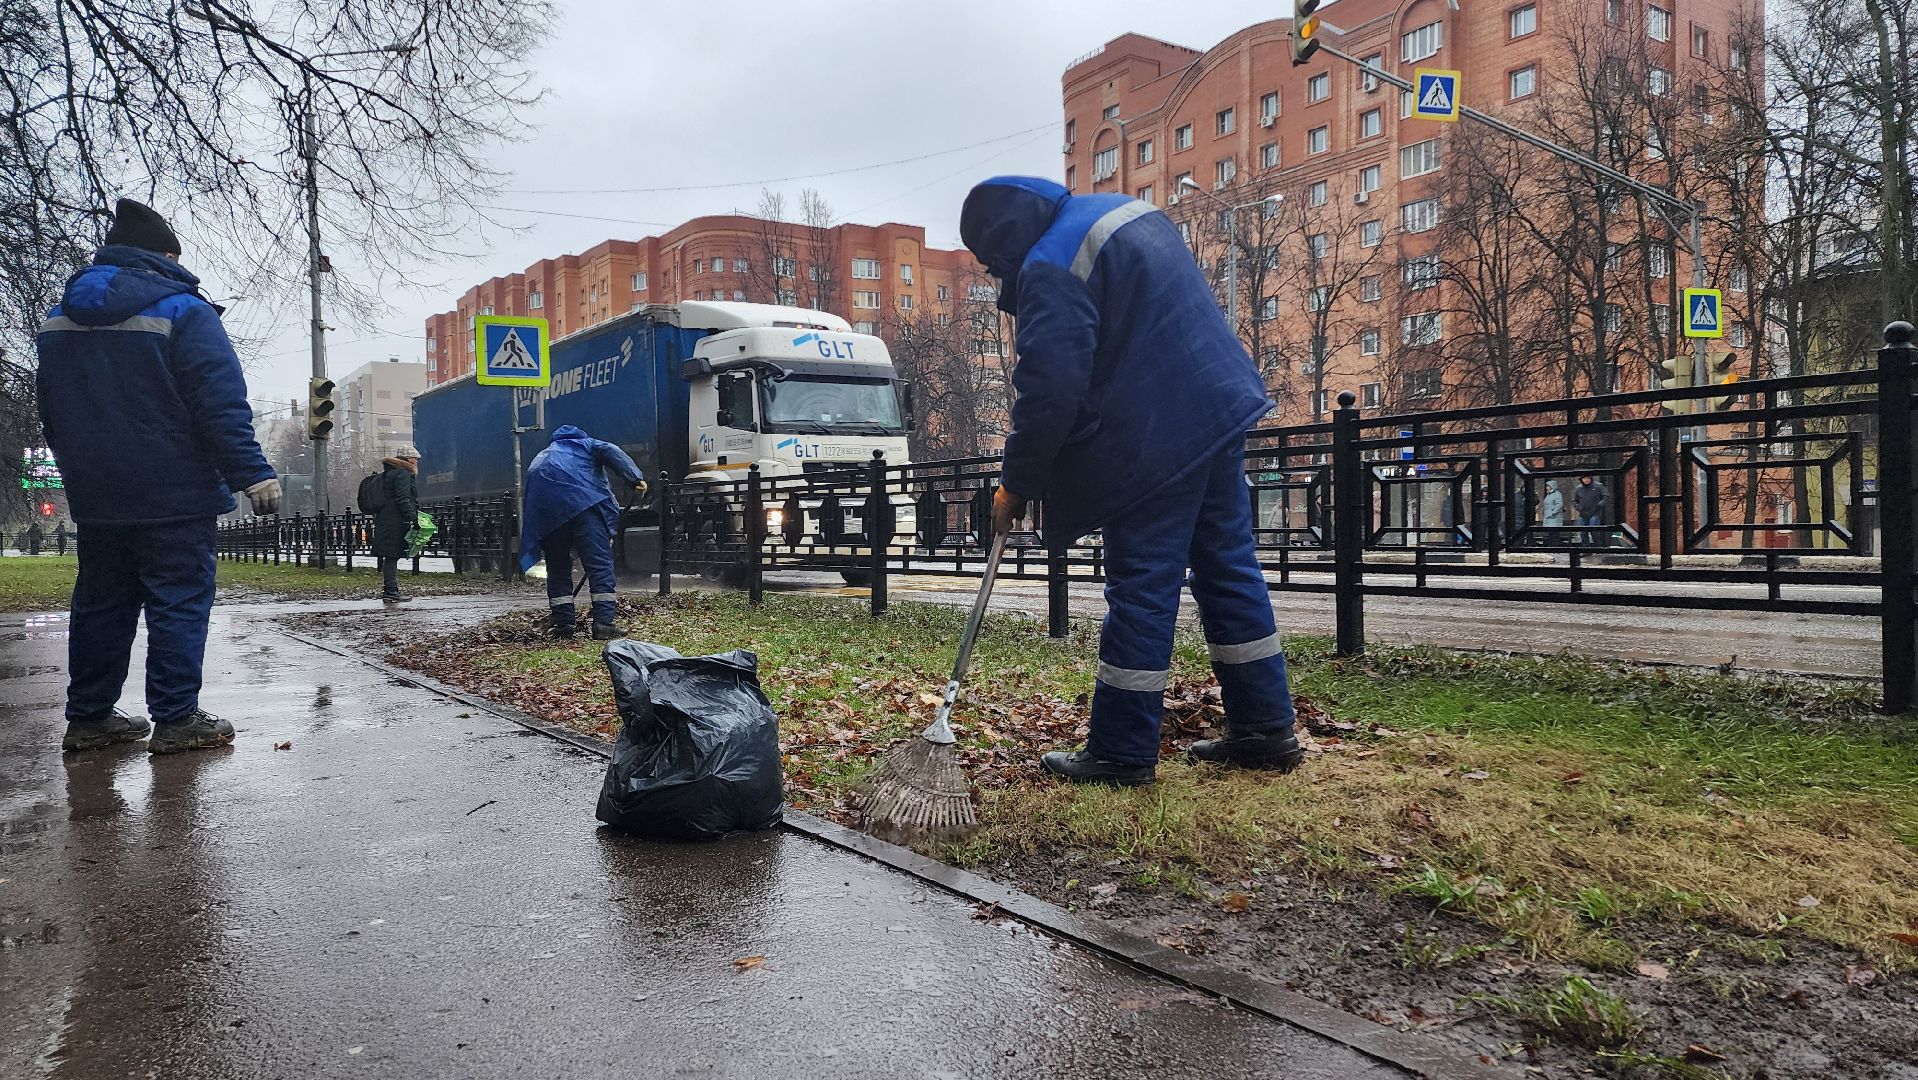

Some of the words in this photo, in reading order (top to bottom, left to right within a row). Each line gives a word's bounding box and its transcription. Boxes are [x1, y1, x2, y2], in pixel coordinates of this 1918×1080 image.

[818, 340, 854, 359] GLT
[583, 355, 620, 390] FLEET
[703, 438, 714, 453] GLT
[795, 444, 819, 458] GLT
[824, 446, 841, 457] 1272
